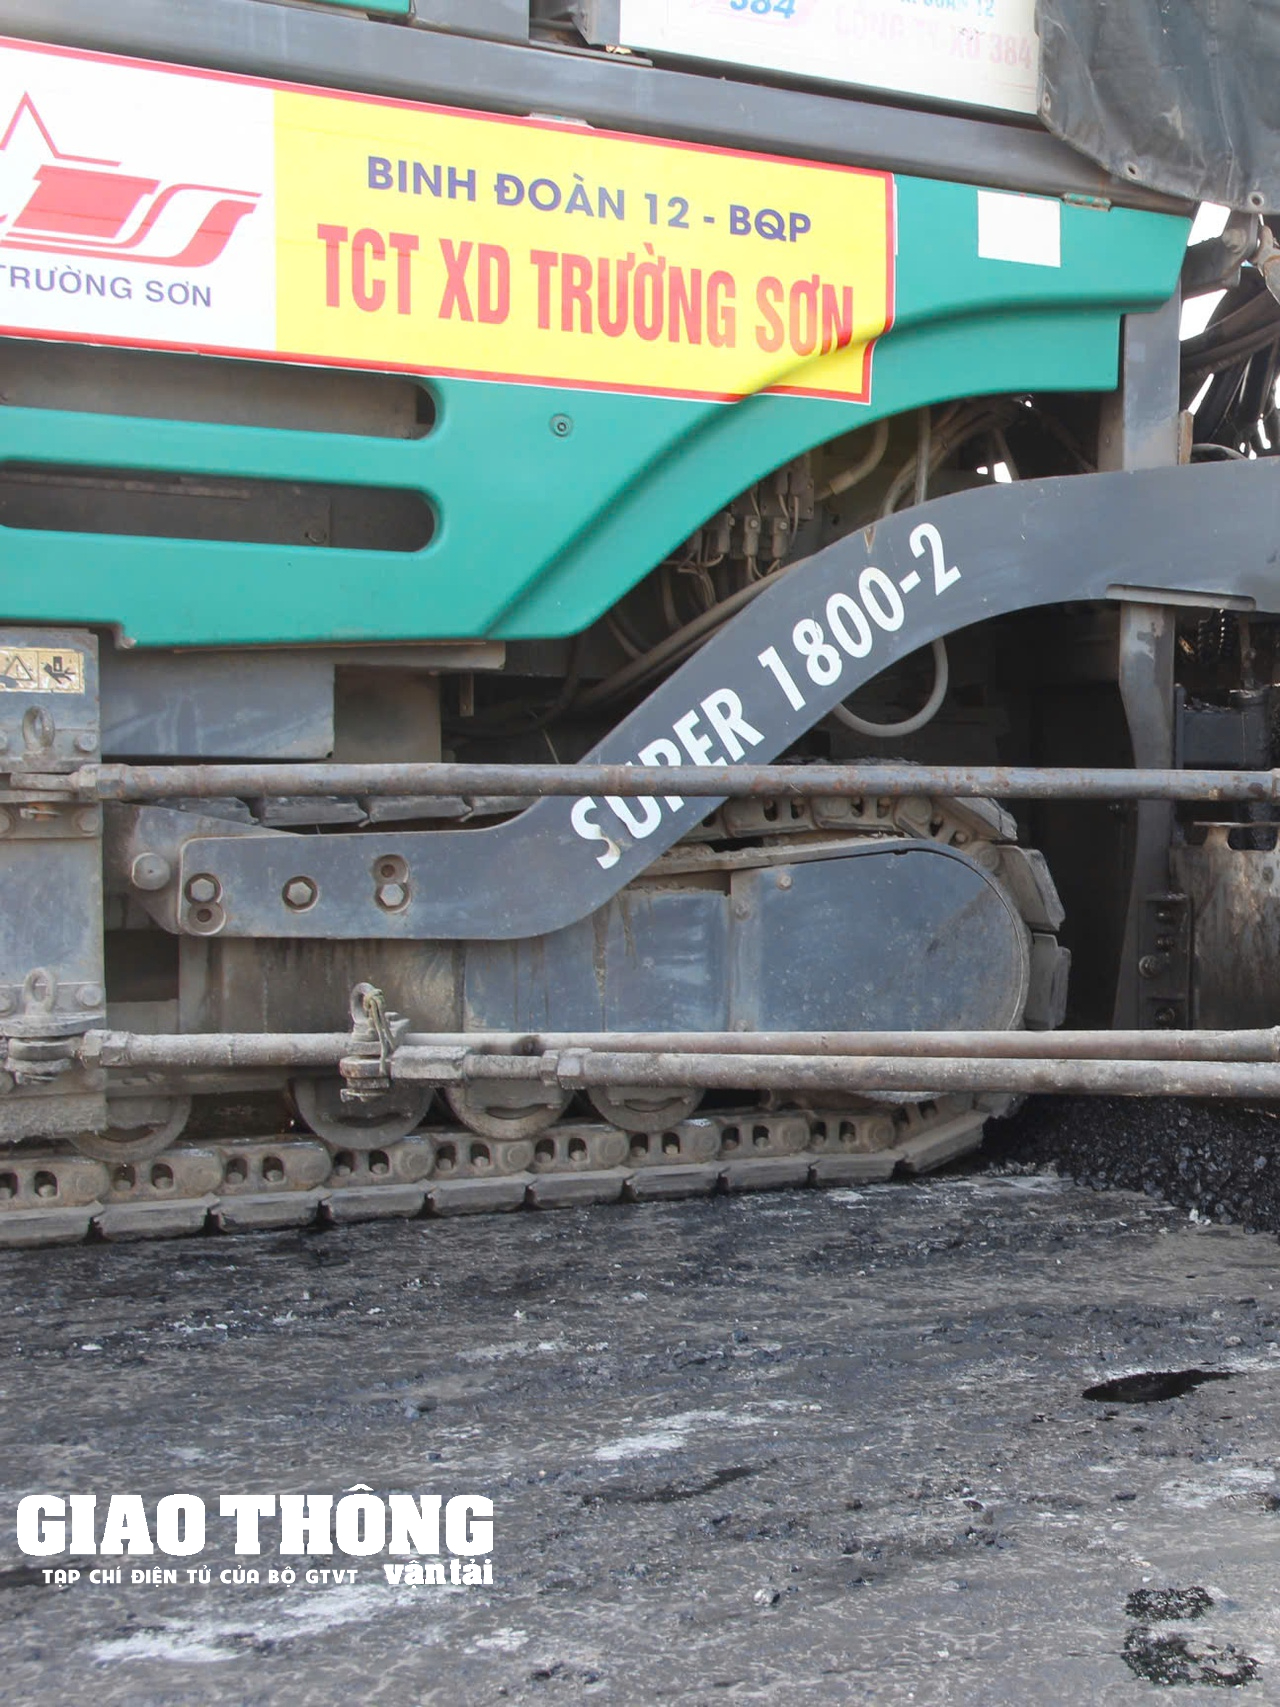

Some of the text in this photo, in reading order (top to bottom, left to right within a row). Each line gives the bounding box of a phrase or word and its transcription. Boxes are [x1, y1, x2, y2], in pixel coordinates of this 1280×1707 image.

[367, 155, 811, 243] BINH ĐOÀN 12 - BQP
[145, 281, 211, 308] SƠN
[317, 223, 853, 356] TCT XD TRƯỜNG SƠN
[757, 523, 961, 711] 1800-2
